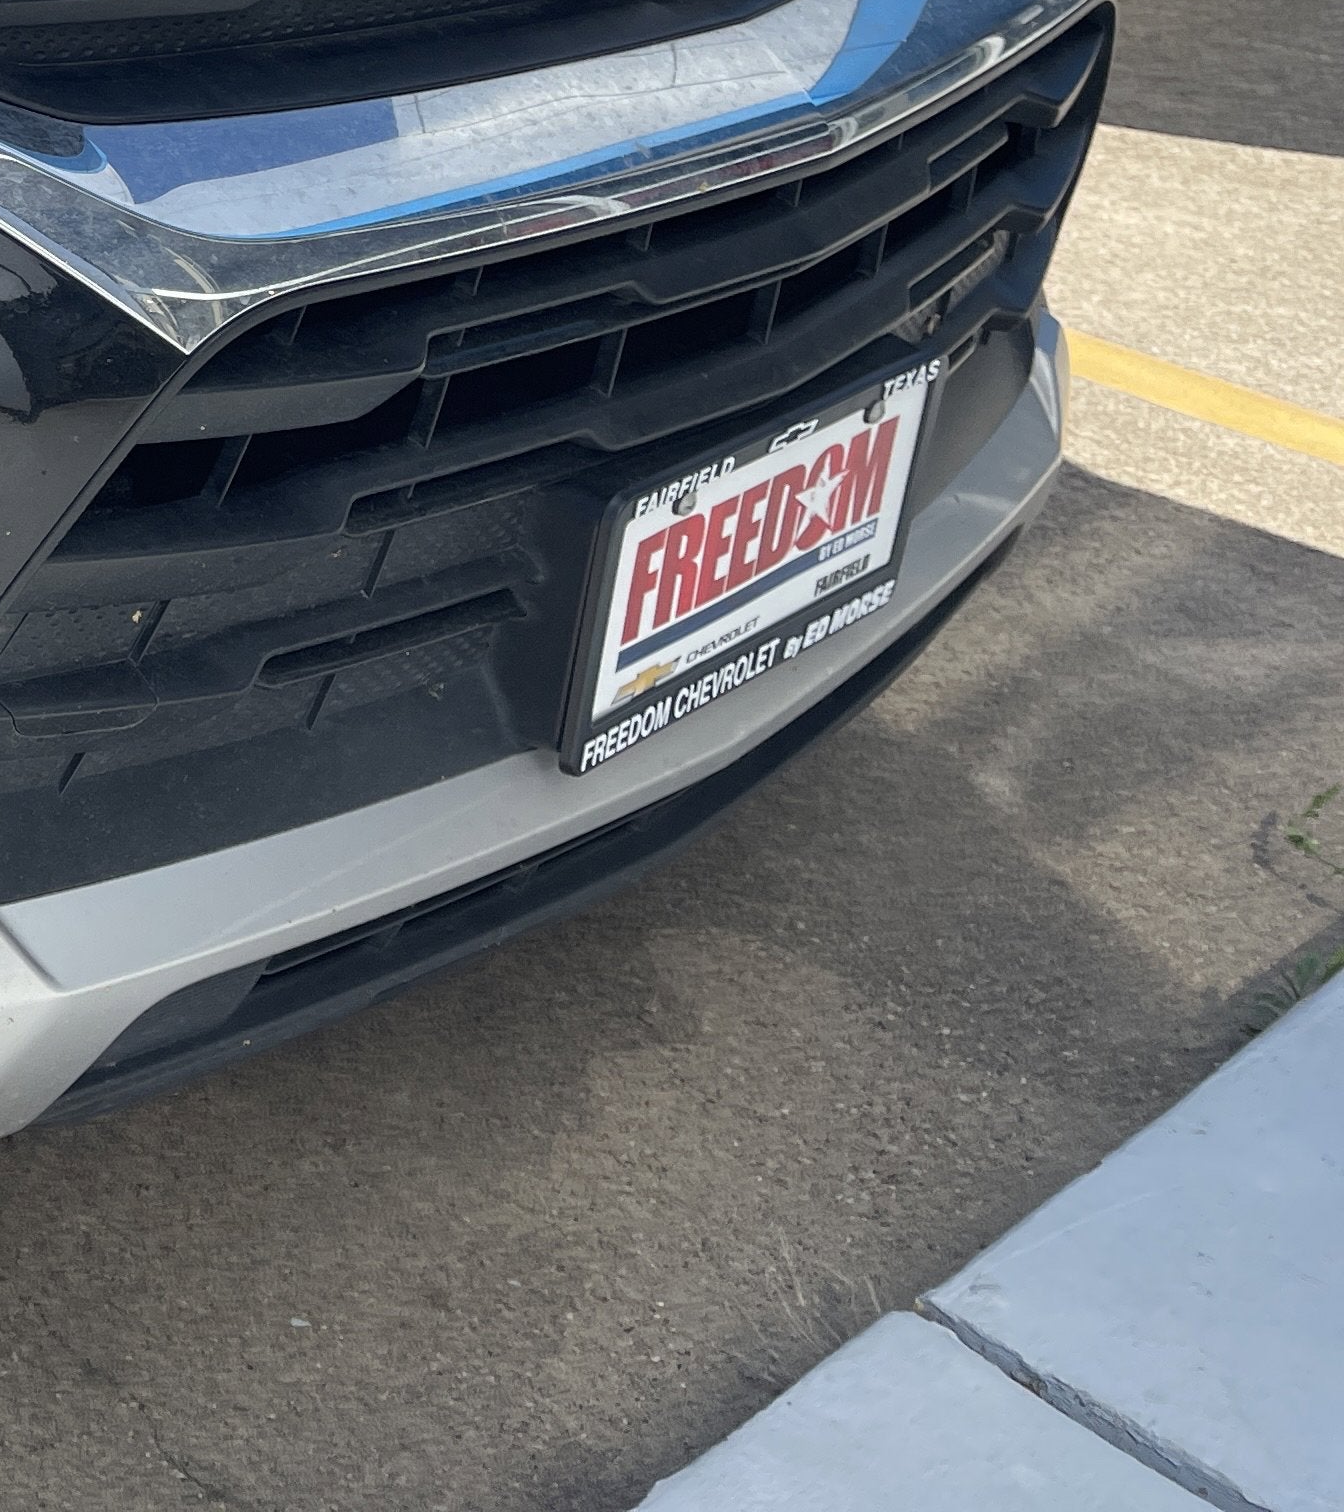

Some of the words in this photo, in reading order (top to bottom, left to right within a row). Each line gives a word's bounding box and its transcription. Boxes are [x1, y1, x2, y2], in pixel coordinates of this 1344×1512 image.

[634, 457, 736, 521] FAIRFIELD
[882, 359, 941, 400] TEXAS
[620, 414, 902, 648] FREEDOM
[814, 554, 871, 597] FAIRFIELD
[580, 695, 673, 773] FREEDOM
[673, 637, 781, 720] CHEVROLET
[802, 614, 831, 649] ED
[828, 579, 896, 635] MORSE
[686, 615, 761, 664] CHEVROLET
